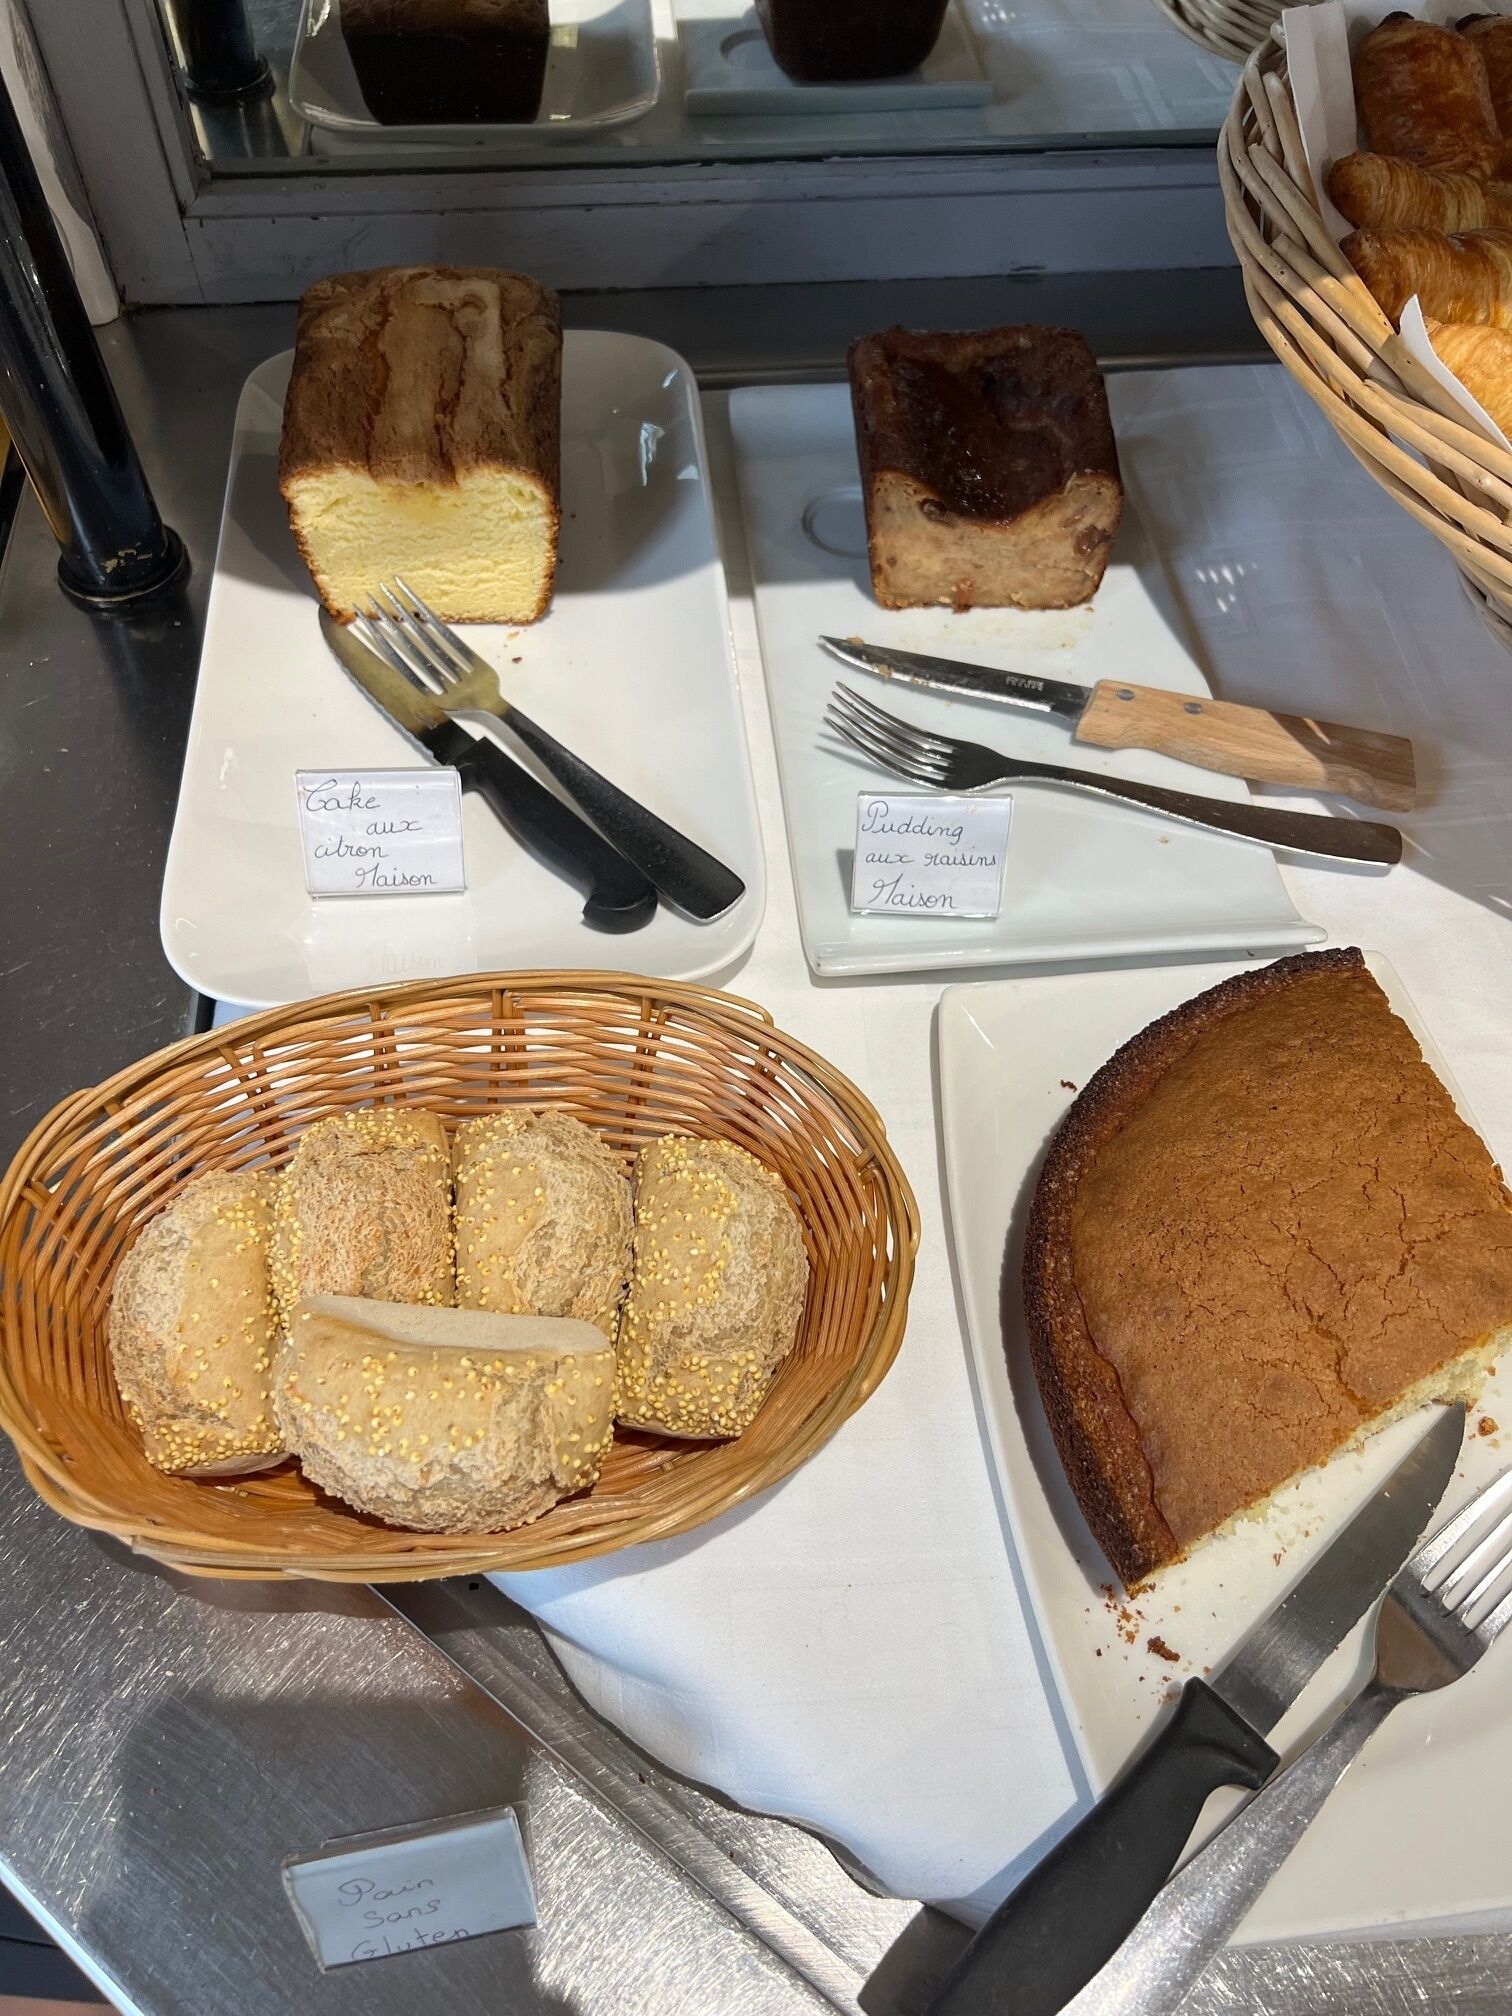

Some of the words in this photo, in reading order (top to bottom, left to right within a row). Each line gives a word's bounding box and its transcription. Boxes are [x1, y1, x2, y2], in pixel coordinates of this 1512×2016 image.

[303, 779, 380, 811] Cake
[366, 820, 423, 836] aux
[861, 800, 964, 845] Pudding
[865, 852, 915, 864] aux
[924, 846, 996, 867] raisins
[355, 863, 437, 888] Maison
[867, 873, 959, 909] Maison
[338, 1878, 434, 1906] Pain
